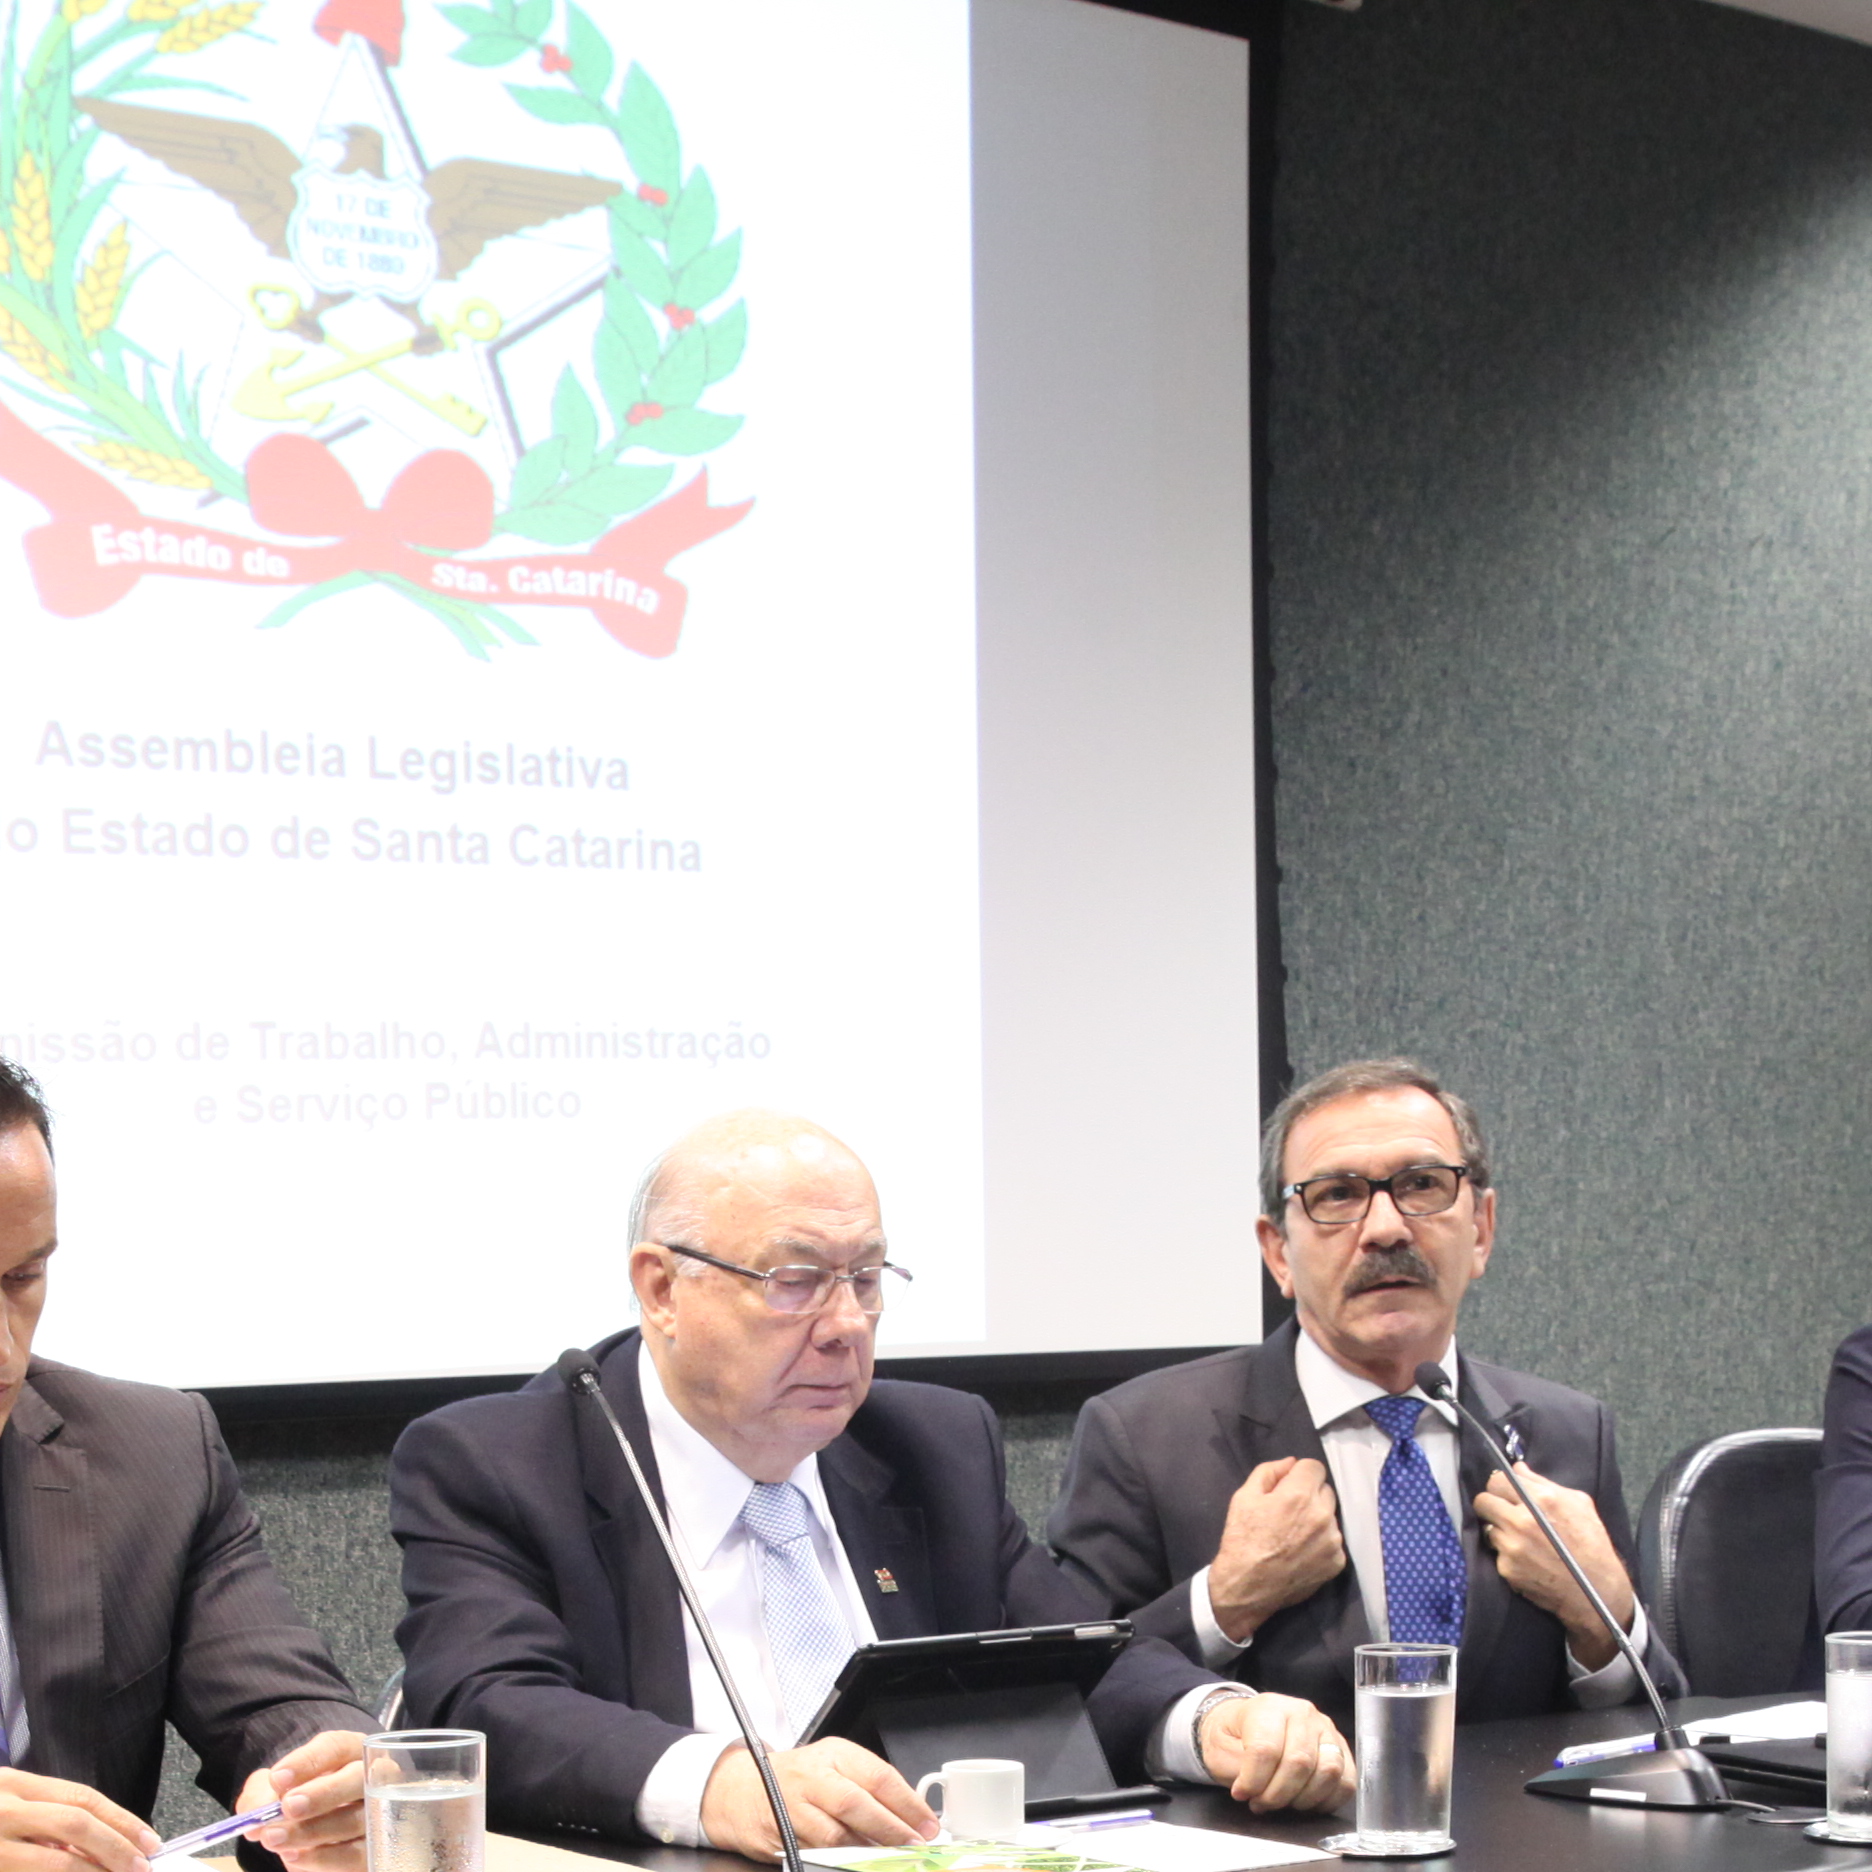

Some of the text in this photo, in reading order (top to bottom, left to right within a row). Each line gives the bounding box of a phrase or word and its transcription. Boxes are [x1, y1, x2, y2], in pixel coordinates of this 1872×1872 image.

[90, 523, 660, 615] Estado de Sta. Catarina
[35, 720, 631, 796] Assembleia Legislativa
[62, 807, 250, 858] Estado
[271, 815, 332, 861] de
[352, 816, 491, 866] Santa
[509, 823, 703, 873] Catarina
[175, 1022, 230, 1061] de
[249, 1020, 459, 1066] Trabalho,
[474, 1020, 772, 1069] Administração
[194, 1080, 583, 1132] e Serviço Público
